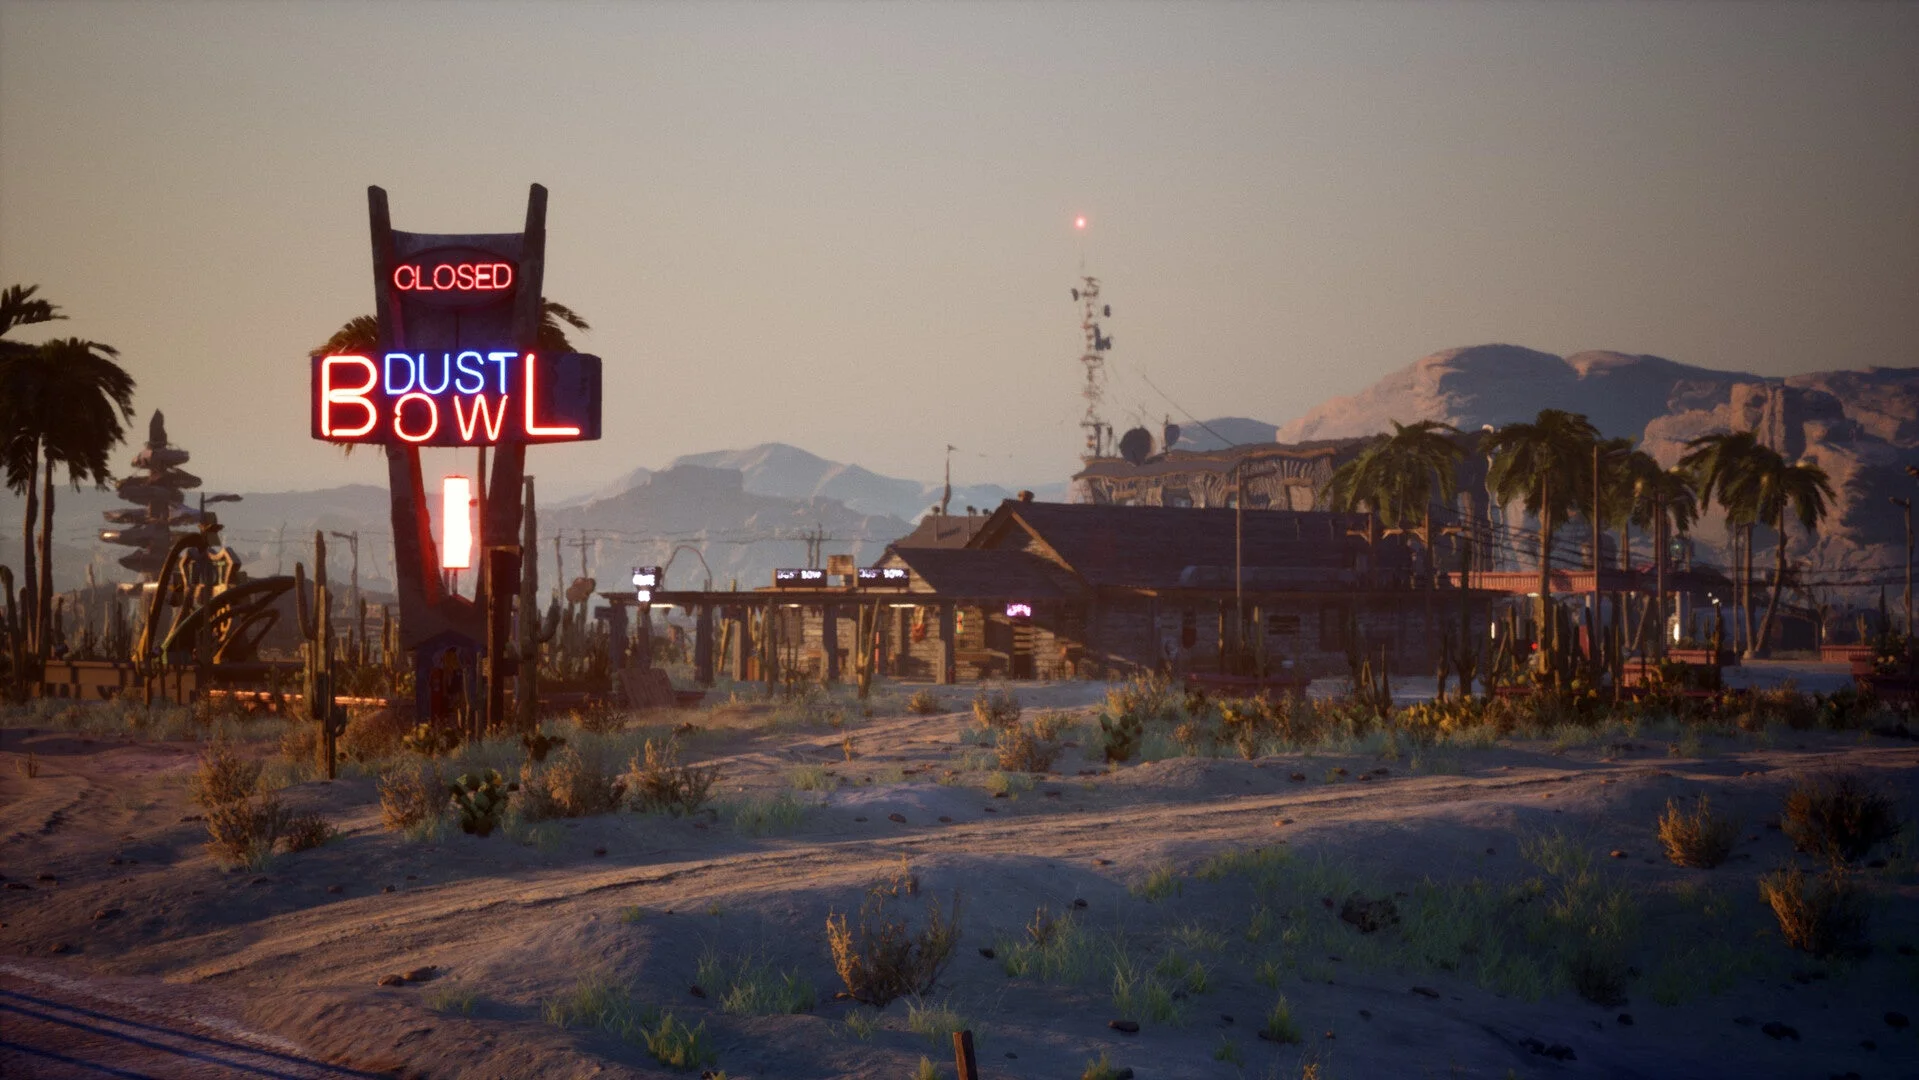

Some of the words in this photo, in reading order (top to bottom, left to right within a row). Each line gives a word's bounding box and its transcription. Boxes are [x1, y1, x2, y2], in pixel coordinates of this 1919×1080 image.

[393, 263, 512, 291] CLOSED
[383, 350, 519, 395] DUST
[320, 352, 581, 443] BOWL
